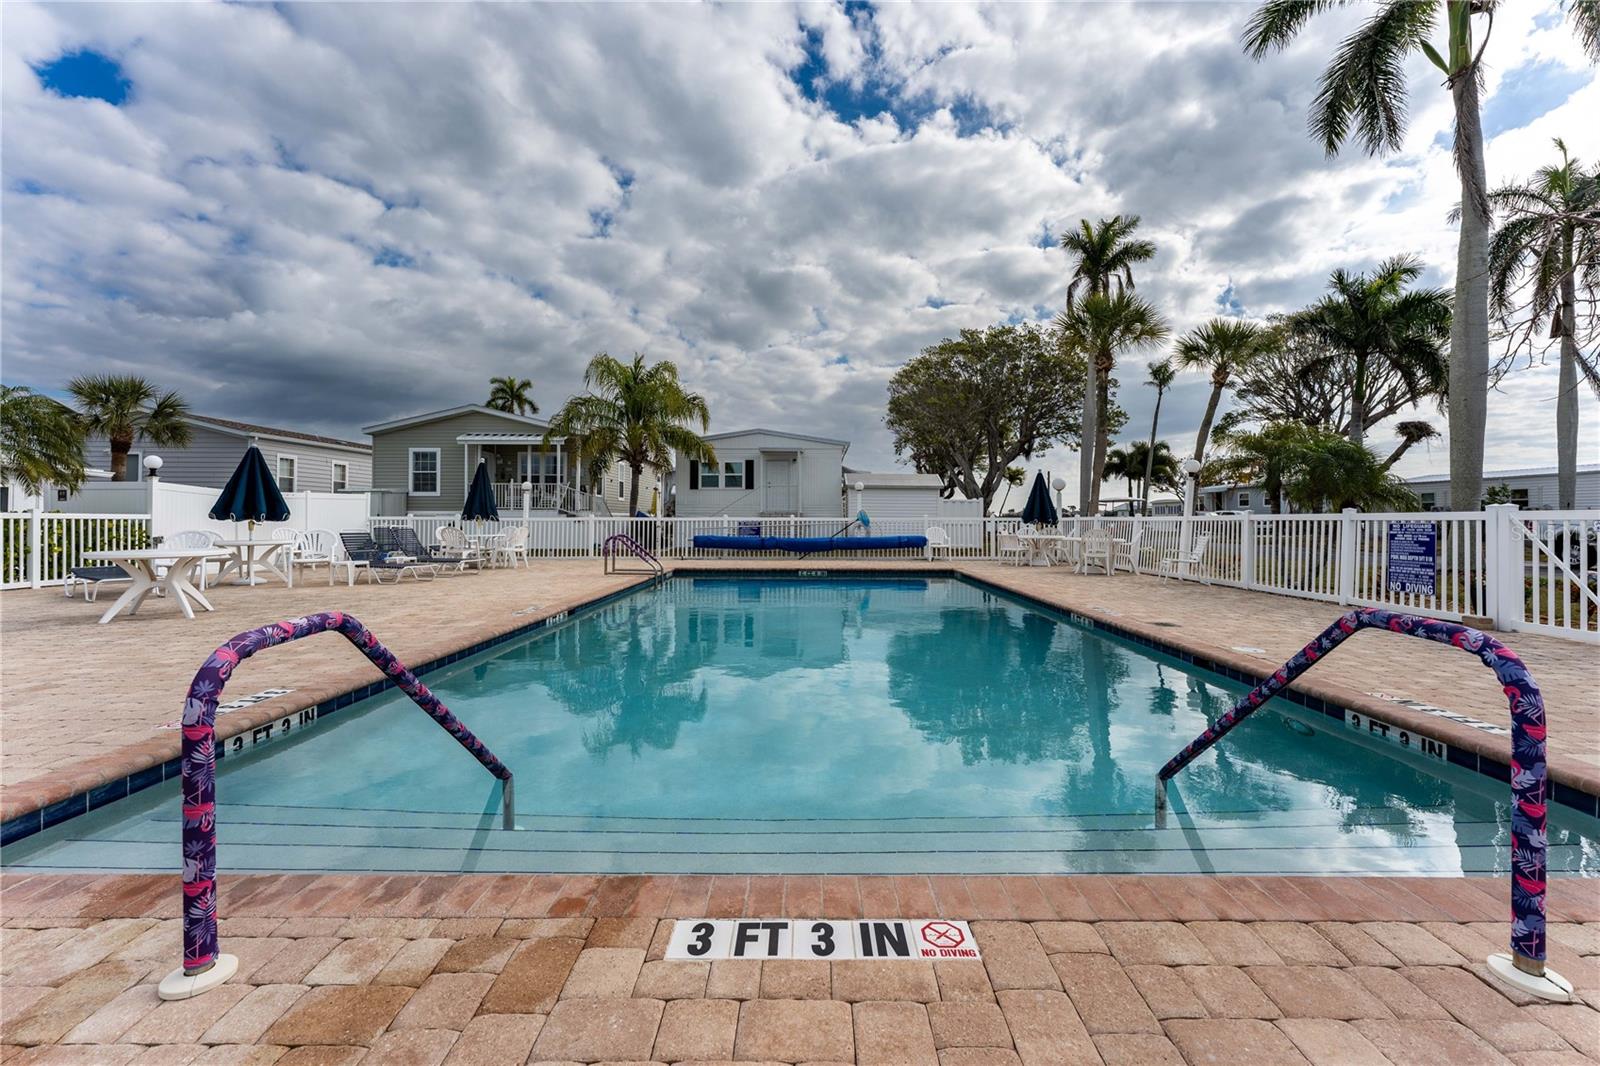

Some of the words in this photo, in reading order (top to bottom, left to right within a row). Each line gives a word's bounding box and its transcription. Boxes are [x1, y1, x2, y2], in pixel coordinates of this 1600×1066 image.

[1390, 582, 1401, 591] NO
[1406, 584, 1433, 594] DIVING
[253, 724, 273, 744] FT
[299, 708, 315, 725] IN
[1369, 719, 1390, 736] FT
[1421, 738, 1443, 757] IN
[687, 922, 715, 956] 3
[733, 922, 788, 957] FT
[811, 922, 835, 957] 3
[859, 922, 910, 957] IN
[921, 949, 937, 957] NO
[940, 949, 977, 958] DIVING
